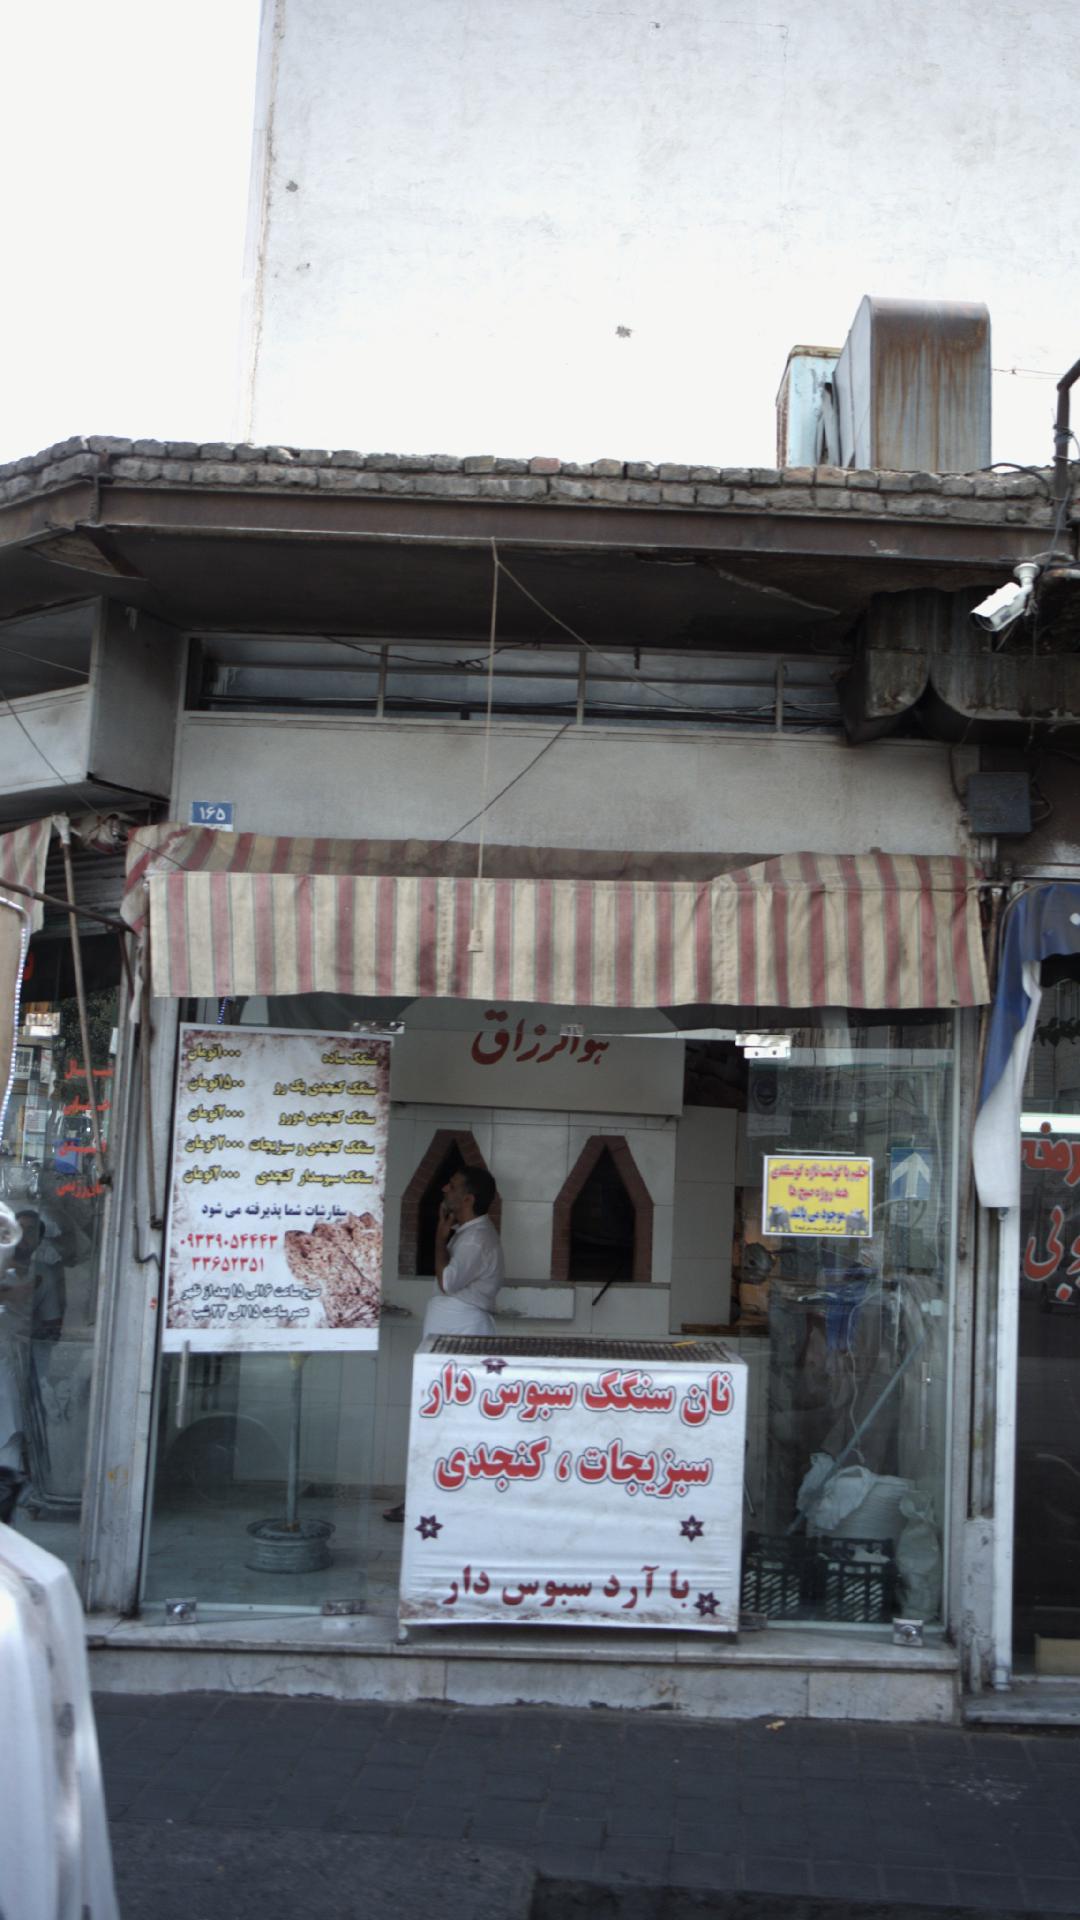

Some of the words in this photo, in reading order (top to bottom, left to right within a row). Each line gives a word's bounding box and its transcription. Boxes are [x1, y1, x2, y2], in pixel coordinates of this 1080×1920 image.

[200, 806, 226, 821] ۱۶۵
[321, 1050, 346, 1065] ساده
[346, 1051, 378, 1065] سنگک
[307, 1080, 346, 1097] کنجدی
[346, 1081, 377, 1095] سنگک
[306, 1110, 345, 1127] کنجدی
[345, 1110, 376, 1125] سنگک
[249, 1137, 295, 1155] سبزیجات
[296, 1143, 304, 1156] و
[305, 1140, 343, 1156] کنجدی
[344, 1140, 375, 1154] سنگک
[255, 1168, 294, 1185] کنجدی
[343, 1170, 374, 1185] سنگک
[202, 1203, 222, 1218] شود
[225, 1207, 241, 1219] می
[245, 1203, 282, 1220] پذیرفته
[284, 1204, 301, 1216] شما
[304, 1204, 347, 1220] سفارشات
[419, 1360, 476, 1417] دار
[582, 1368, 675, 1413] سنگک
[480, 1379, 576, 1420] سبوس
[681, 1372, 734, 1426] نان
[435, 1436, 550, 1492] کنجدی
[577, 1437, 712, 1499] سبزیجات
[442, 1564, 490, 1605] دار
[502, 1579, 592, 1607] سبوس
[603, 1565, 660, 1608] آرد
[670, 1569, 690, 1608] با
